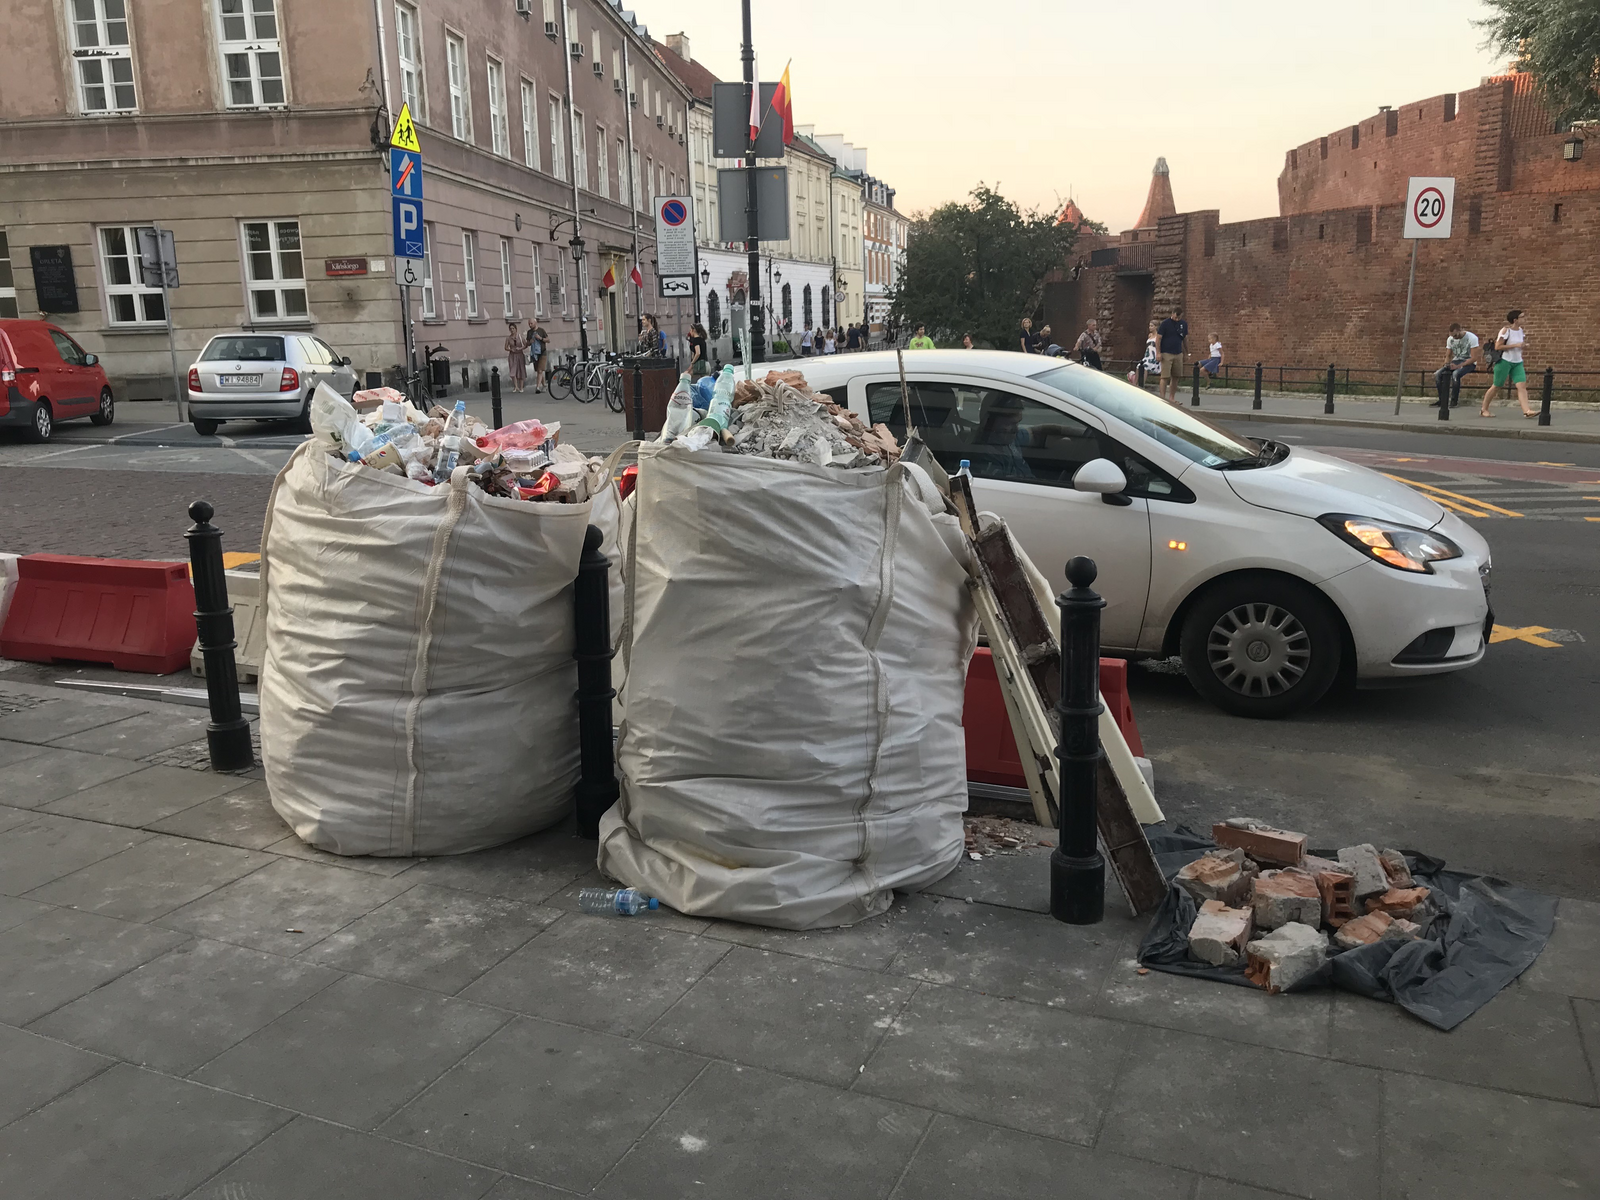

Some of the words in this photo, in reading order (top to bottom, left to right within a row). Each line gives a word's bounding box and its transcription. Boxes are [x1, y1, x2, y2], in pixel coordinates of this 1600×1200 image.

[1419, 198, 1442, 217] 20
[400, 202, 417, 240] P
[331, 262, 360, 271] Kilińskiego
